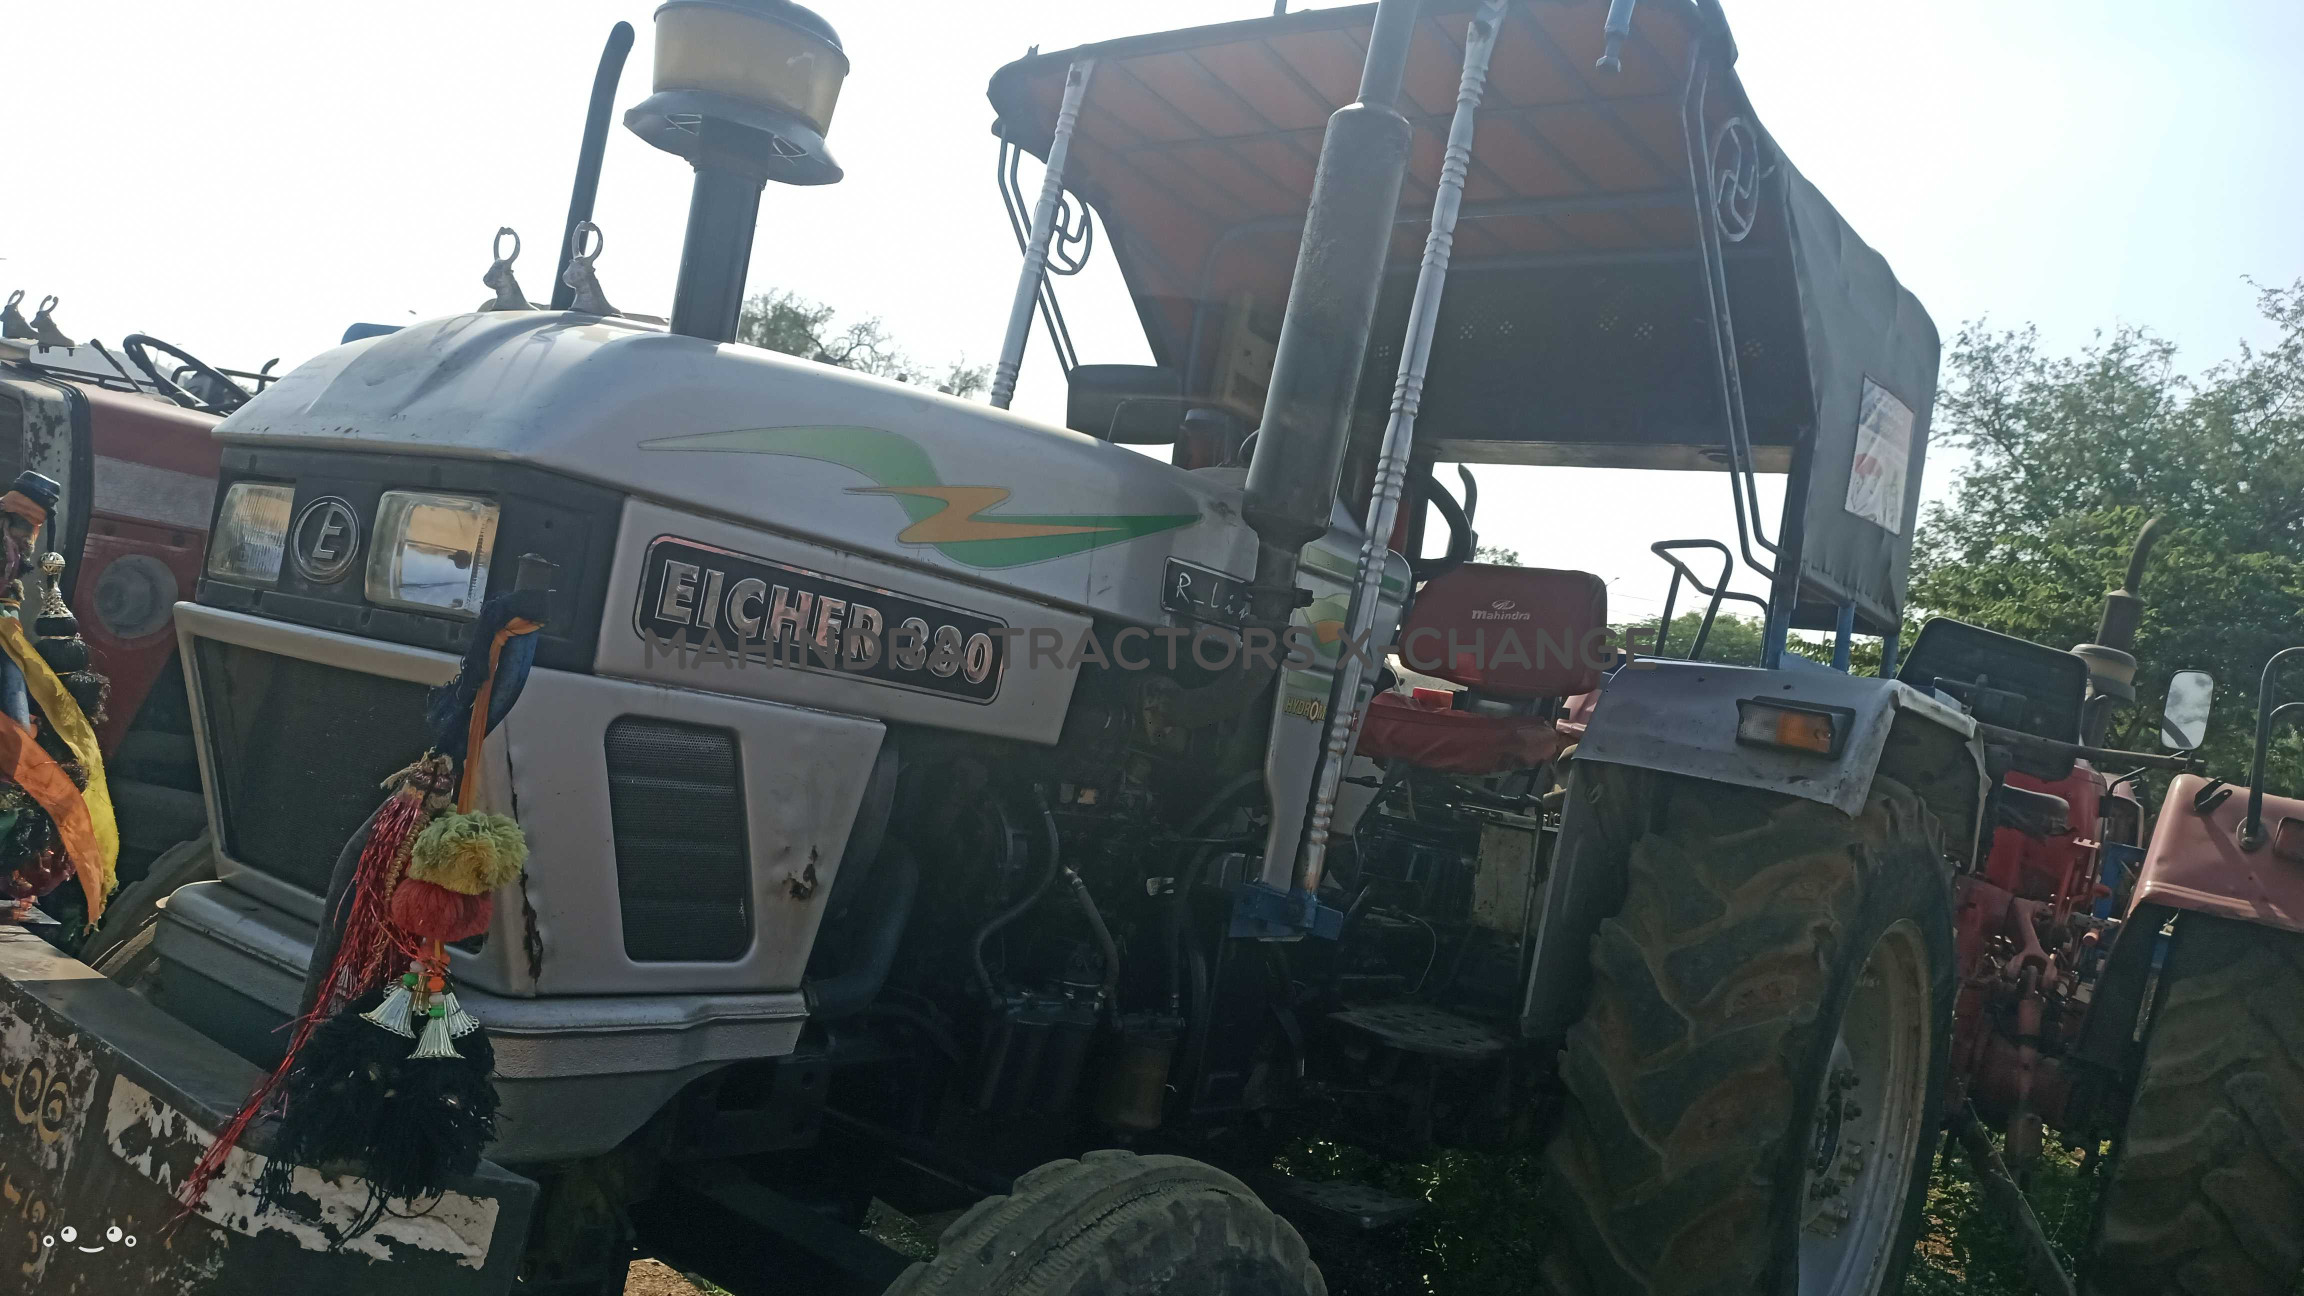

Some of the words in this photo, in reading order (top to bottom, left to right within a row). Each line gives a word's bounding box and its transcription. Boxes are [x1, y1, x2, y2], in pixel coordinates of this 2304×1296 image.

[654, 559, 884, 663] EICHER
[896, 616, 993, 685] 380
[1471, 609, 1531, 620] Mahindra
[1285, 696, 1328, 721] HYDROM
